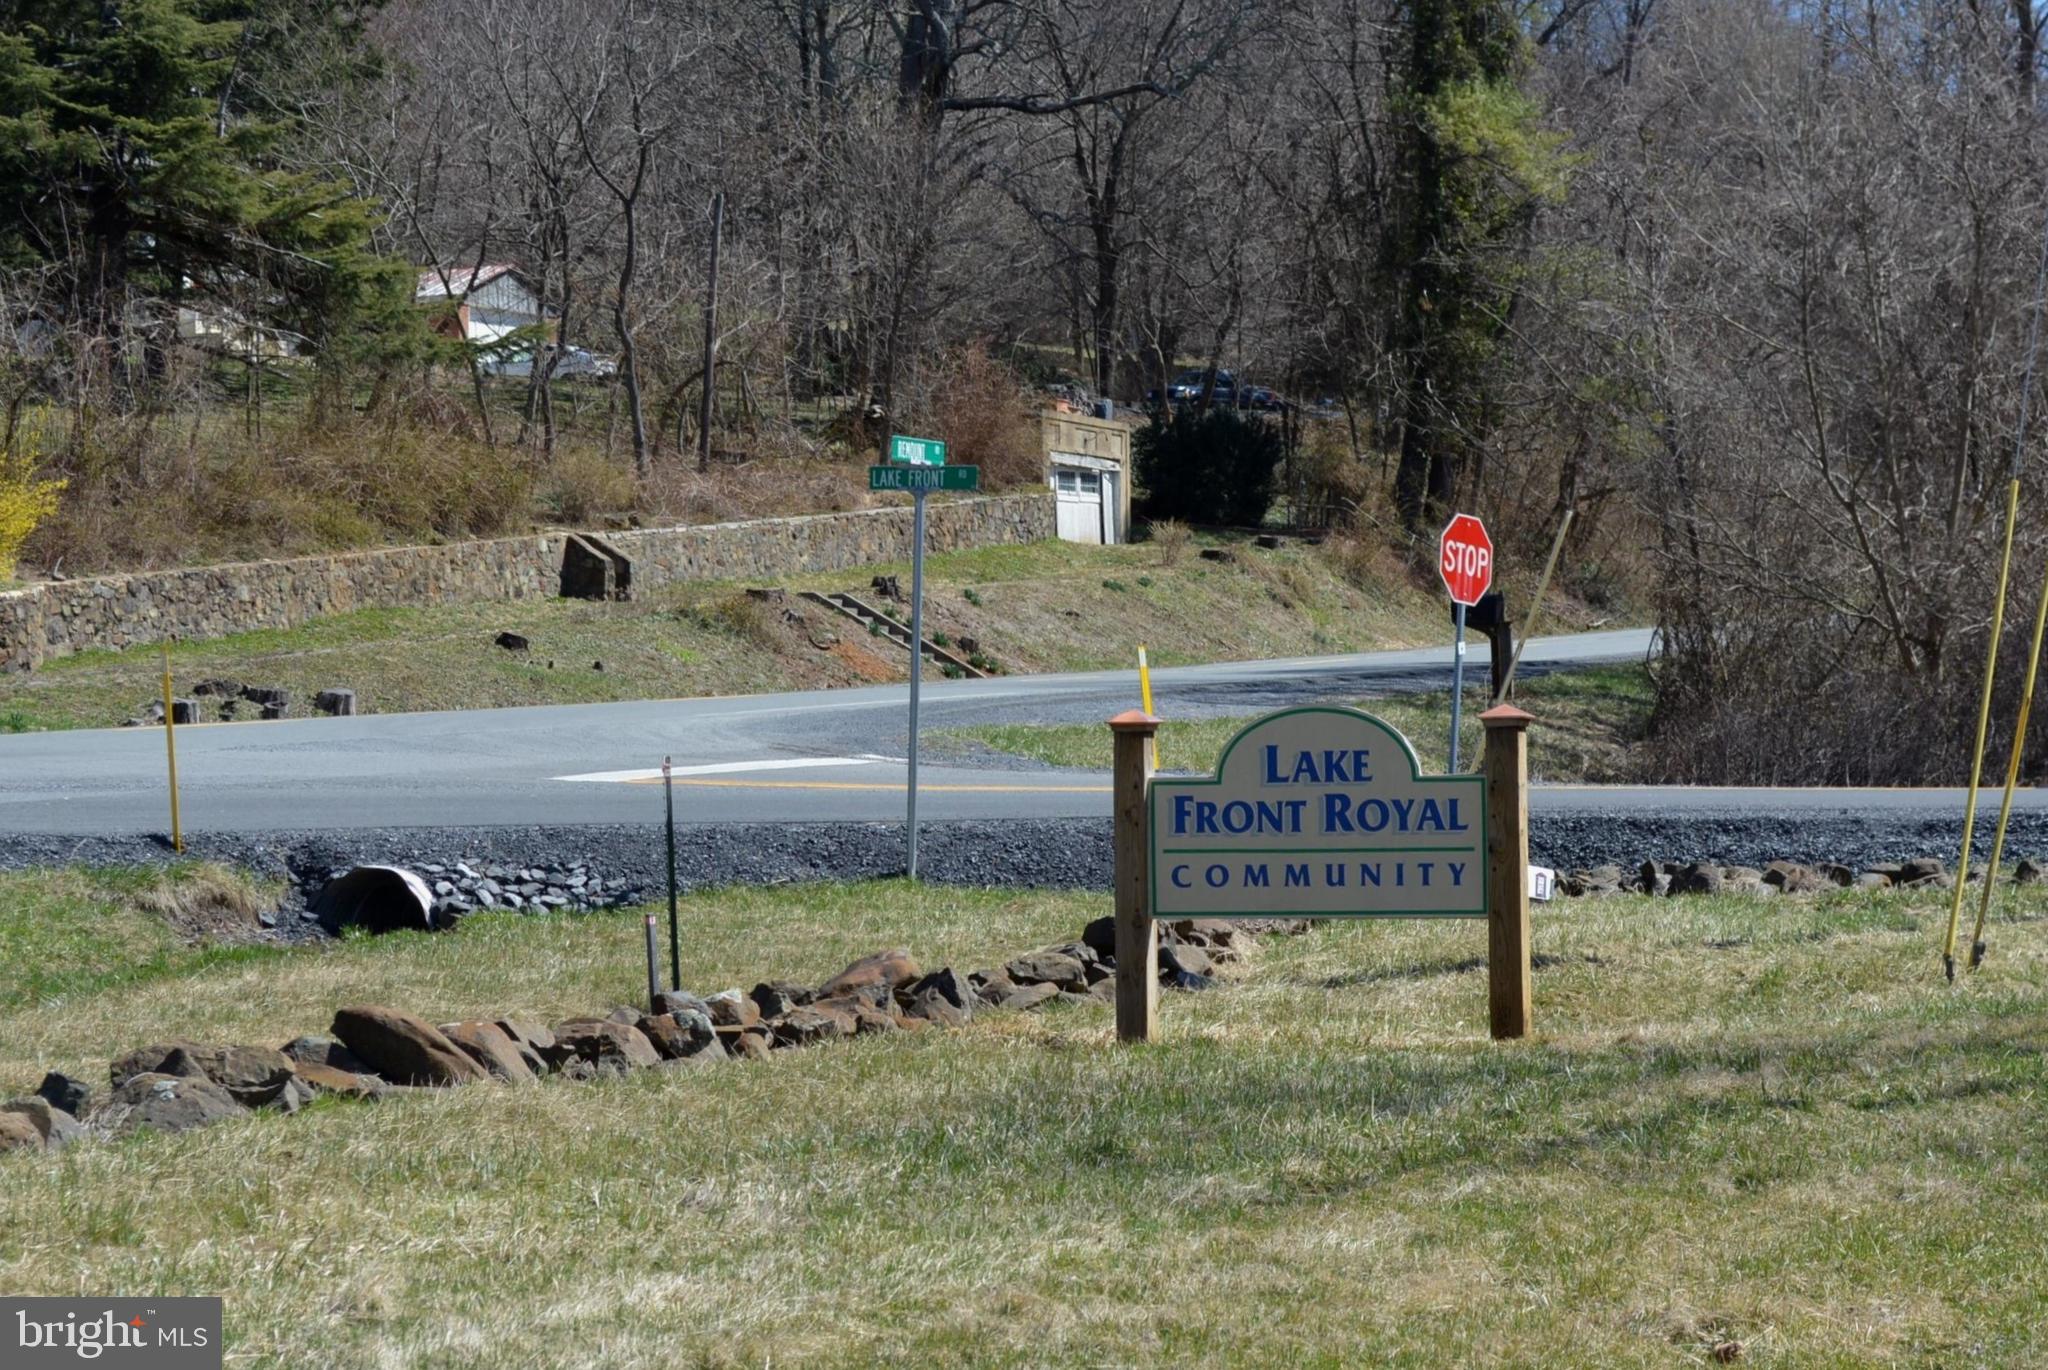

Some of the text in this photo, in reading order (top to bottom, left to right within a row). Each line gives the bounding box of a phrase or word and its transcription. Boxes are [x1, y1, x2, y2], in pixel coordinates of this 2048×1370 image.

[872, 470, 902, 487] LAKE
[909, 470, 945, 487] FRONT
[1444, 540, 1489, 578] STOP
[1263, 745, 1373, 785] LAKE
[1171, 793, 1469, 835] FRONT ROYAL
[1171, 862, 1467, 888] COMMUNITY
